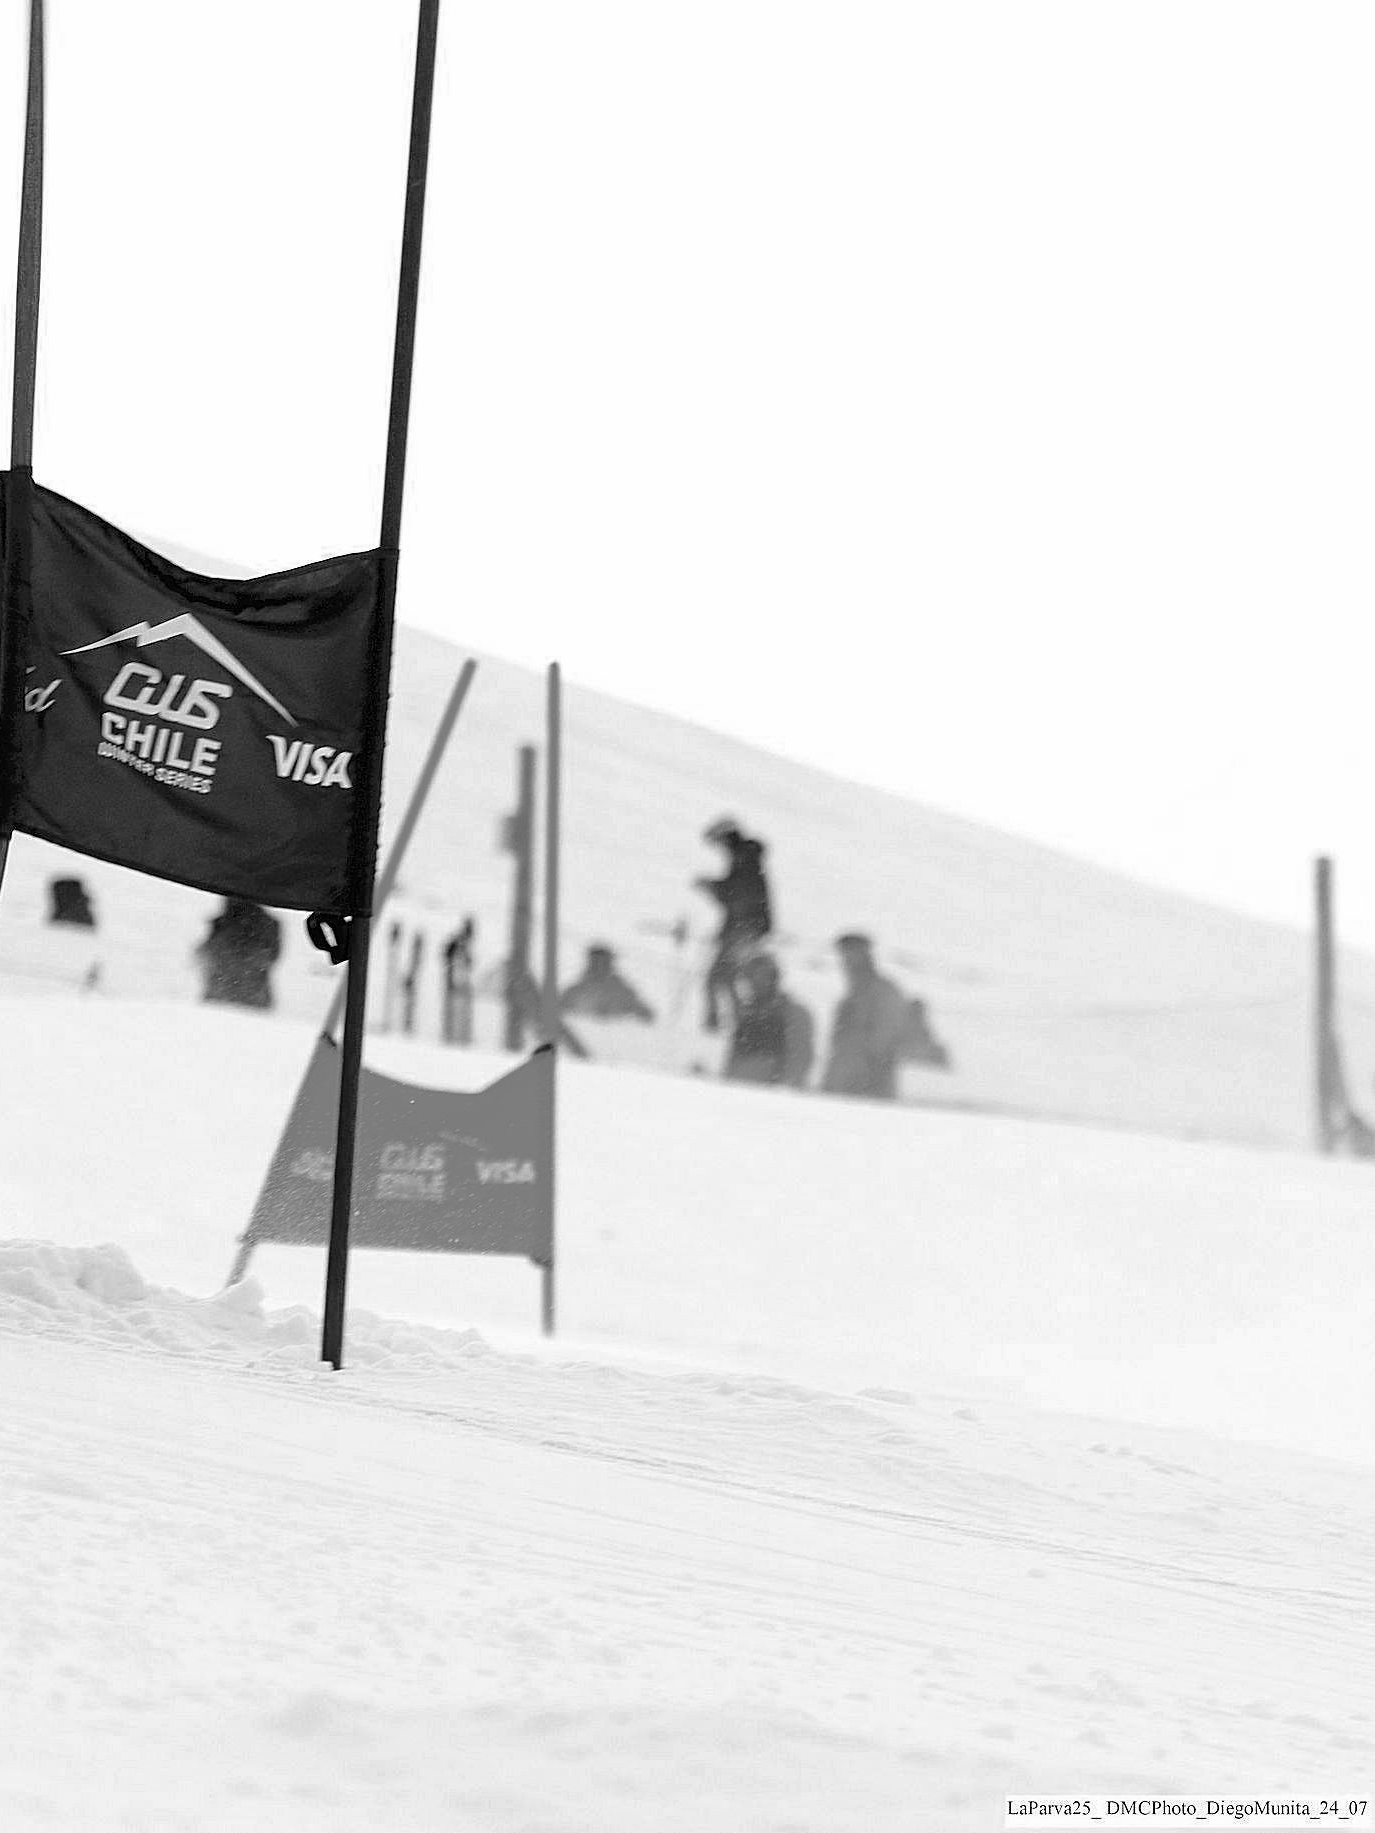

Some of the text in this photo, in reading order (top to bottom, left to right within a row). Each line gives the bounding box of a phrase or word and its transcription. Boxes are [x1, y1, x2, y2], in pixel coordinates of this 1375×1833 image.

[101, 711, 222, 777] CHILE
[266, 735, 353, 789] VISA
[477, 1159, 536, 1184] VISA
